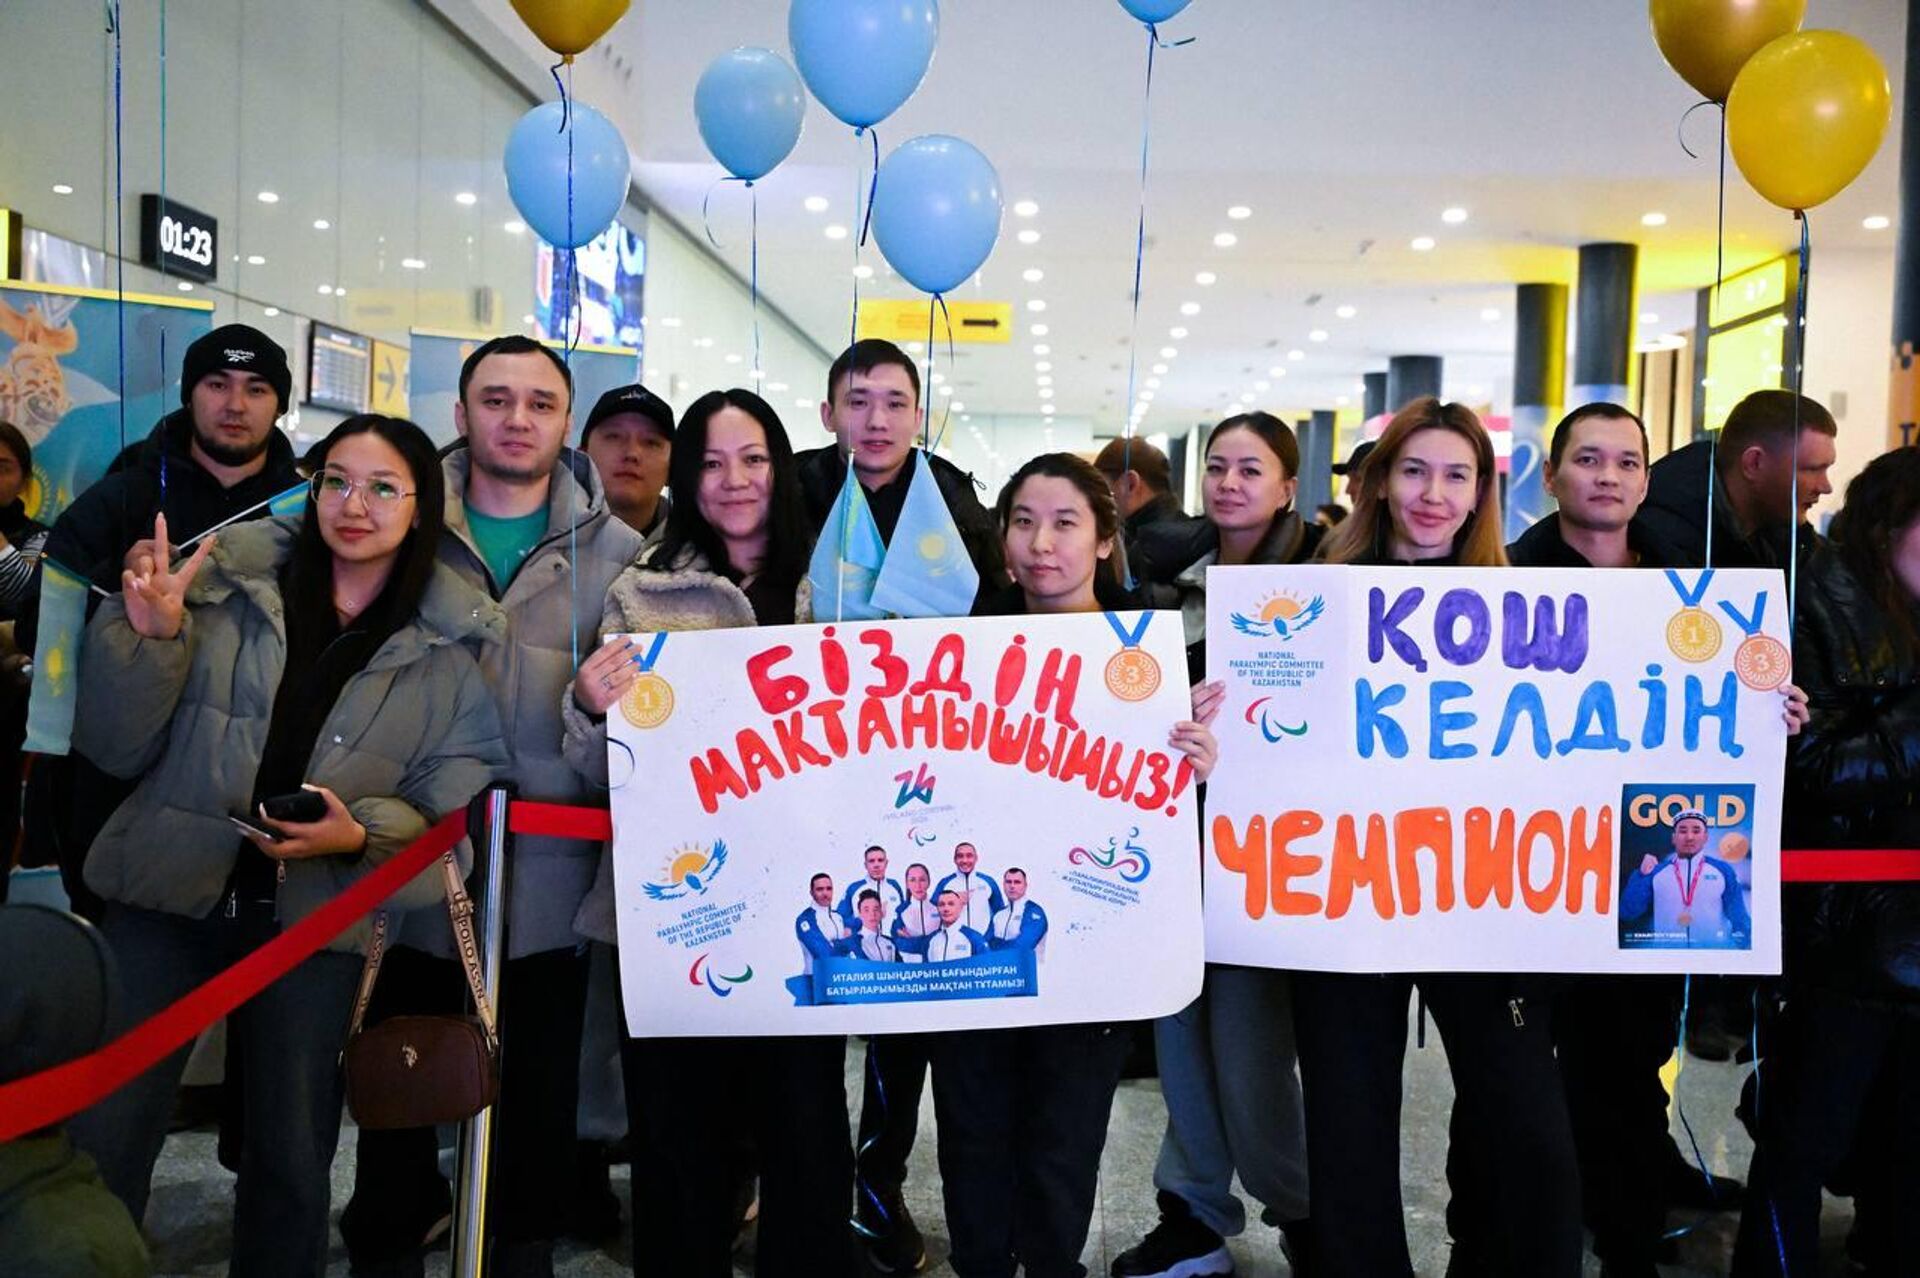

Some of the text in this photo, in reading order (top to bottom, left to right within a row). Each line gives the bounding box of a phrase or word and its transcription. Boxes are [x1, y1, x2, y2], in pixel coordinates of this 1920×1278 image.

[160, 215, 212, 266] 01:23
[1367, 586, 1589, 675] ҚОШ
[1688, 627, 1699, 644] 1
[1229, 660, 1324, 669] PARALYMPIC COMMITTEE
[1258, 652, 1296, 660] NATIONAL
[1754, 653, 1770, 672] 3
[747, 626, 1082, 731] БІЗДІҢ
[1126, 666, 1140, 683] 3
[1237, 669, 1247, 677] OF
[1252, 679, 1301, 687] KAZAKHSTAN
[1355, 663, 1745, 759] КЕЛДІҢ
[691, 694, 1196, 817] МАҚТАНЫШЫМЫЗ!
[1629, 793, 1746, 828] GOLD
[1212, 807, 1612, 919] ЧЕМПИОН
[656, 901, 747, 938] PARALYMPIC COMMITTEE
[681, 902, 718, 919] NATIONAL
[457, 917, 474, 958] POLO
[668, 913, 742, 944] OF THE REPUBLIC OF
[684, 927, 732, 948] KAZAKHSTAN
[832, 973, 874, 982] ИТАЛИЯ
[826, 984, 928, 996] БАТЫРЛАРЫМЫЗДЫ
